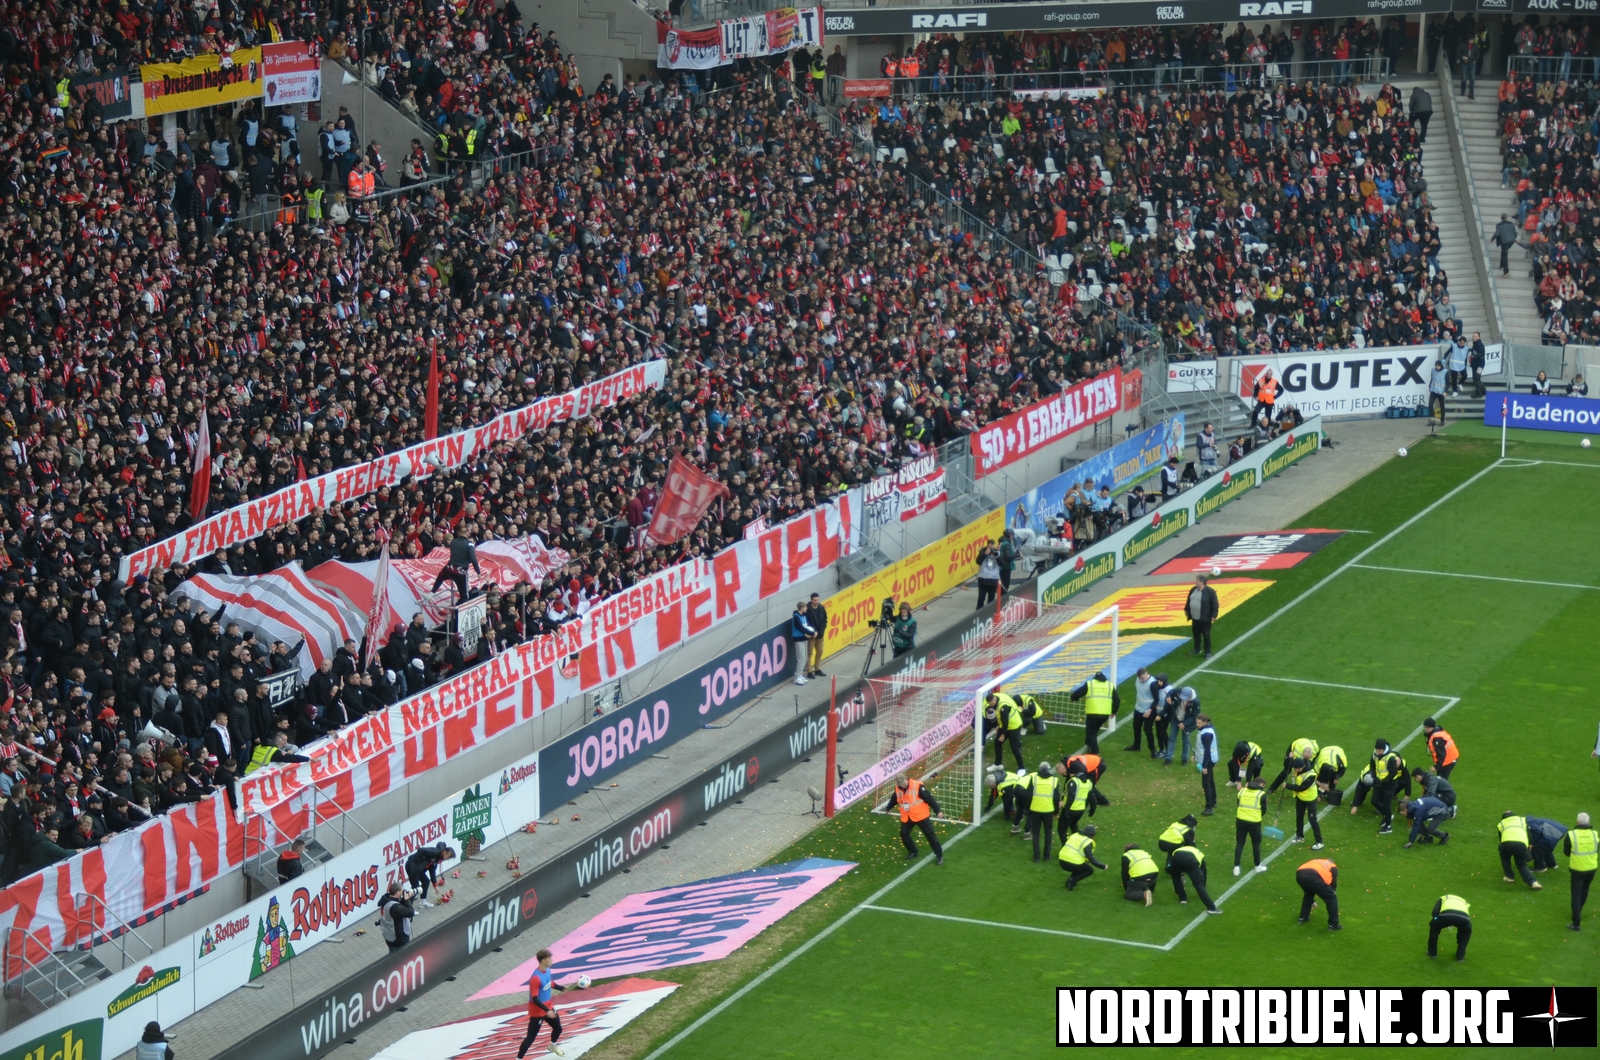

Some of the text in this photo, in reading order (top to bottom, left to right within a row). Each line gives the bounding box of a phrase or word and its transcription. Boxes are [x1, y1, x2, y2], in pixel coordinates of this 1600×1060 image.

[912, 13, 987, 28] RAFI
[1044, 11, 1100, 22] rafi-group.com
[1240, 1, 1312, 17] RAFI
[1575, 0, 1597, 9] Die
[163, 71, 202, 96] Dreisam
[1179, 368, 1214, 377] GUTEX
[1281, 355, 1428, 392] GUTEX
[1486, 351, 1500, 360] TEX
[1028, 375, 1117, 448] ERHALTEN
[1326, 401, 1344, 411] MIT
[1350, 397, 1386, 411] JEDER
[1390, 394, 1426, 407] FASER
[1113, 443, 1162, 483] EUROPA PARK
[1262, 434, 1318, 478] Schwarzwaldmilch
[126, 537, 178, 587] EIN
[182, 478, 326, 563] FINANZHAI
[335, 453, 401, 503] HEILT
[472, 394, 576, 457] KRANKES
[1195, 472, 1256, 519] Schwarzwaldmilch
[1123, 509, 1188, 562] Schwarzwaldmilch
[903, 564, 935, 598] LOTTO
[1043, 553, 1115, 607] Schwarzwaldmilch
[842, 596, 875, 632] LOTTO
[241, 763, 303, 813] FÜR
[309, 712, 395, 781] EINEN
[400, 619, 584, 737] NACHHALTIGEN
[590, 558, 702, 640] FUSSBALL!
[698, 635, 788, 714] JOBRAD
[956, 700, 976, 728] JOBRA
[566, 700, 670, 787] JOBRAD
[918, 724, 951, 752] JOBRAD
[510, 761, 537, 786] Rothaus
[880, 748, 913, 777] JOBRAD
[704, 760, 747, 811] wiha
[838, 773, 873, 803] JOBRAD
[454, 796, 490, 819] TANNEN
[455, 812, 489, 835] ZÄPFLE
[383, 814, 448, 866] TANNEN
[576, 806, 672, 888] wiha.com
[290, 864, 378, 941] Rothaus
[214, 914, 250, 944] Rothaus
[467, 895, 520, 955] wiha
[108, 968, 180, 1017] Schwarzwaldmilch
[301, 954, 425, 1056] wiha.com
